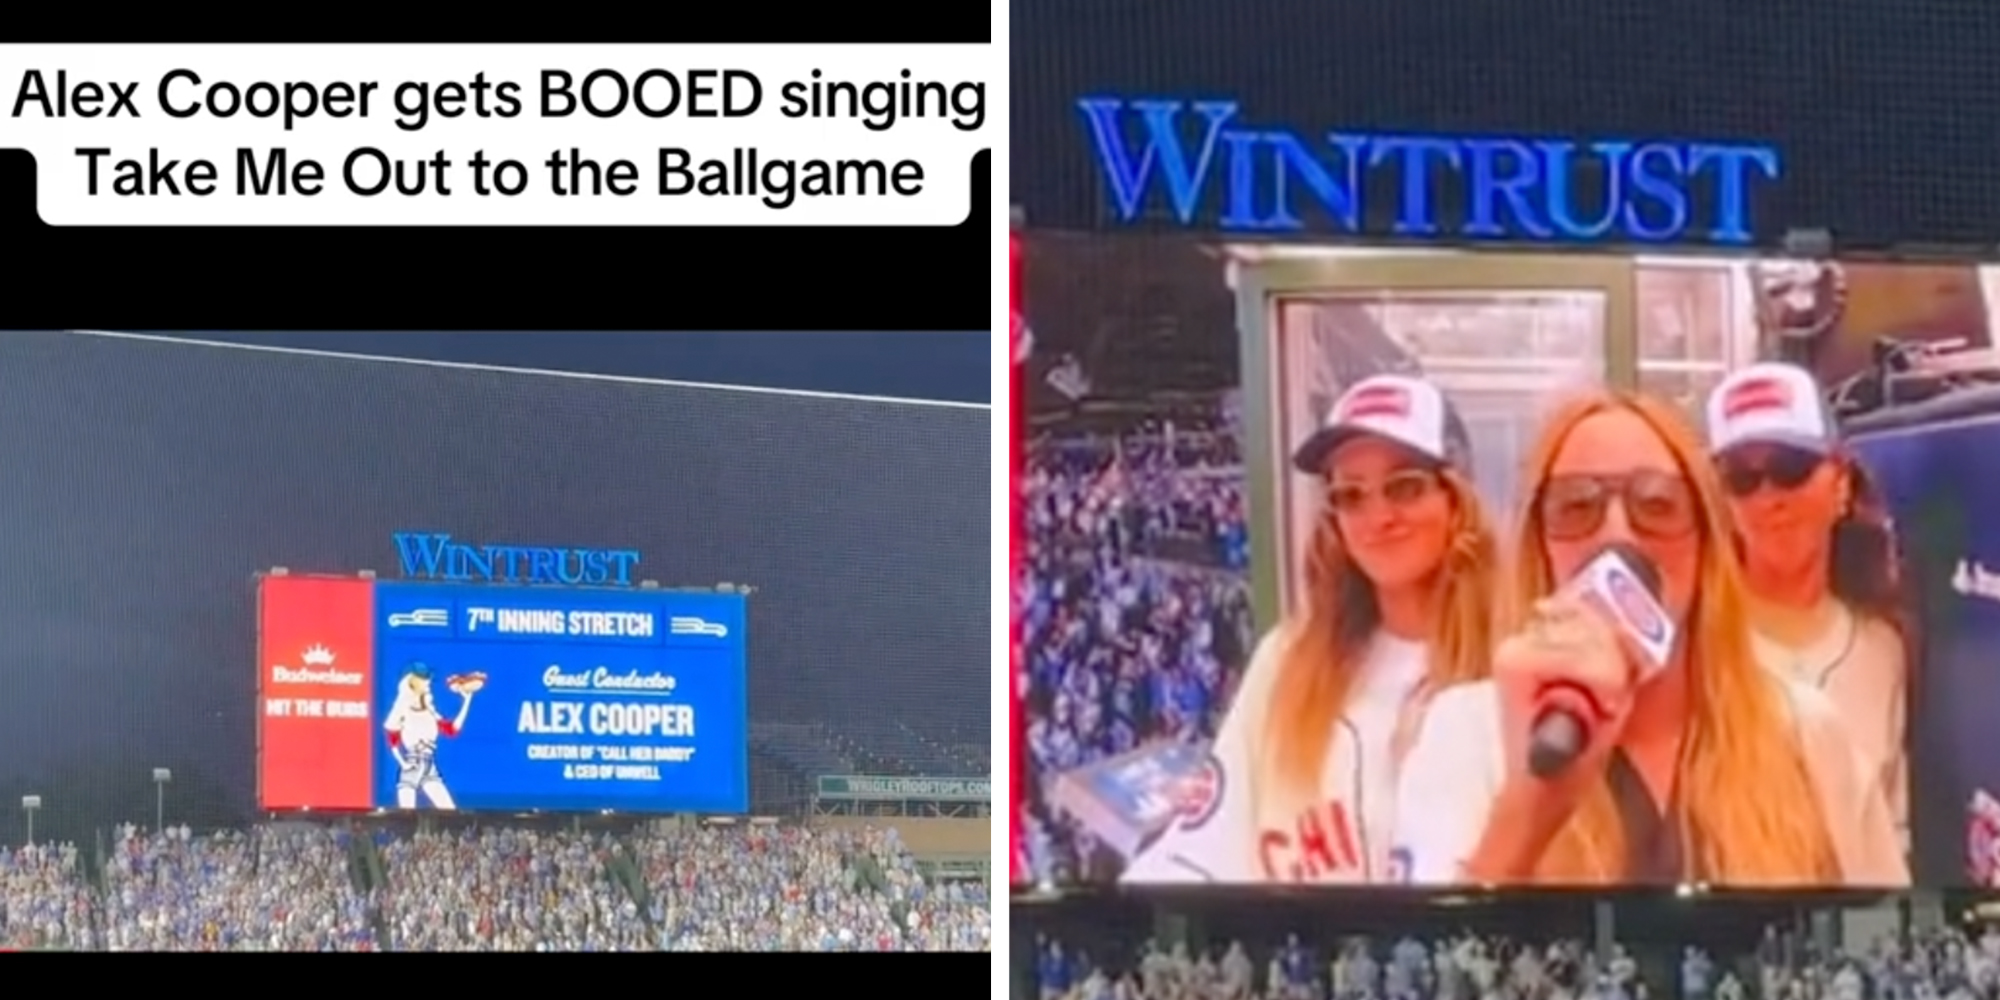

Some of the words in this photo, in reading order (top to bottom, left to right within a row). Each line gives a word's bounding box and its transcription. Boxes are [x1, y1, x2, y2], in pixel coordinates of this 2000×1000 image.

[1078, 96, 1779, 243] WINTRUST
[393, 532, 641, 585] WINTRUST
[466, 607, 495, 632] 7TH
[497, 608, 566, 634] INNING
[567, 610, 654, 637] STRETCH
[272, 665, 364, 686] Budweiser
[542, 664, 592, 688] Guest
[592, 665, 677, 690] Conductor
[295, 698, 324, 718] THE
[517, 700, 586, 734] ALEX
[588, 702, 695, 737] COOPER
[527, 744, 579, 760] CREATOR
[580, 745, 595, 760] OF
[597, 745, 628, 761] "CALL
[629, 746, 653, 761] HER
[575, 764, 598, 779] CEO
[599, 764, 615, 779] OF
